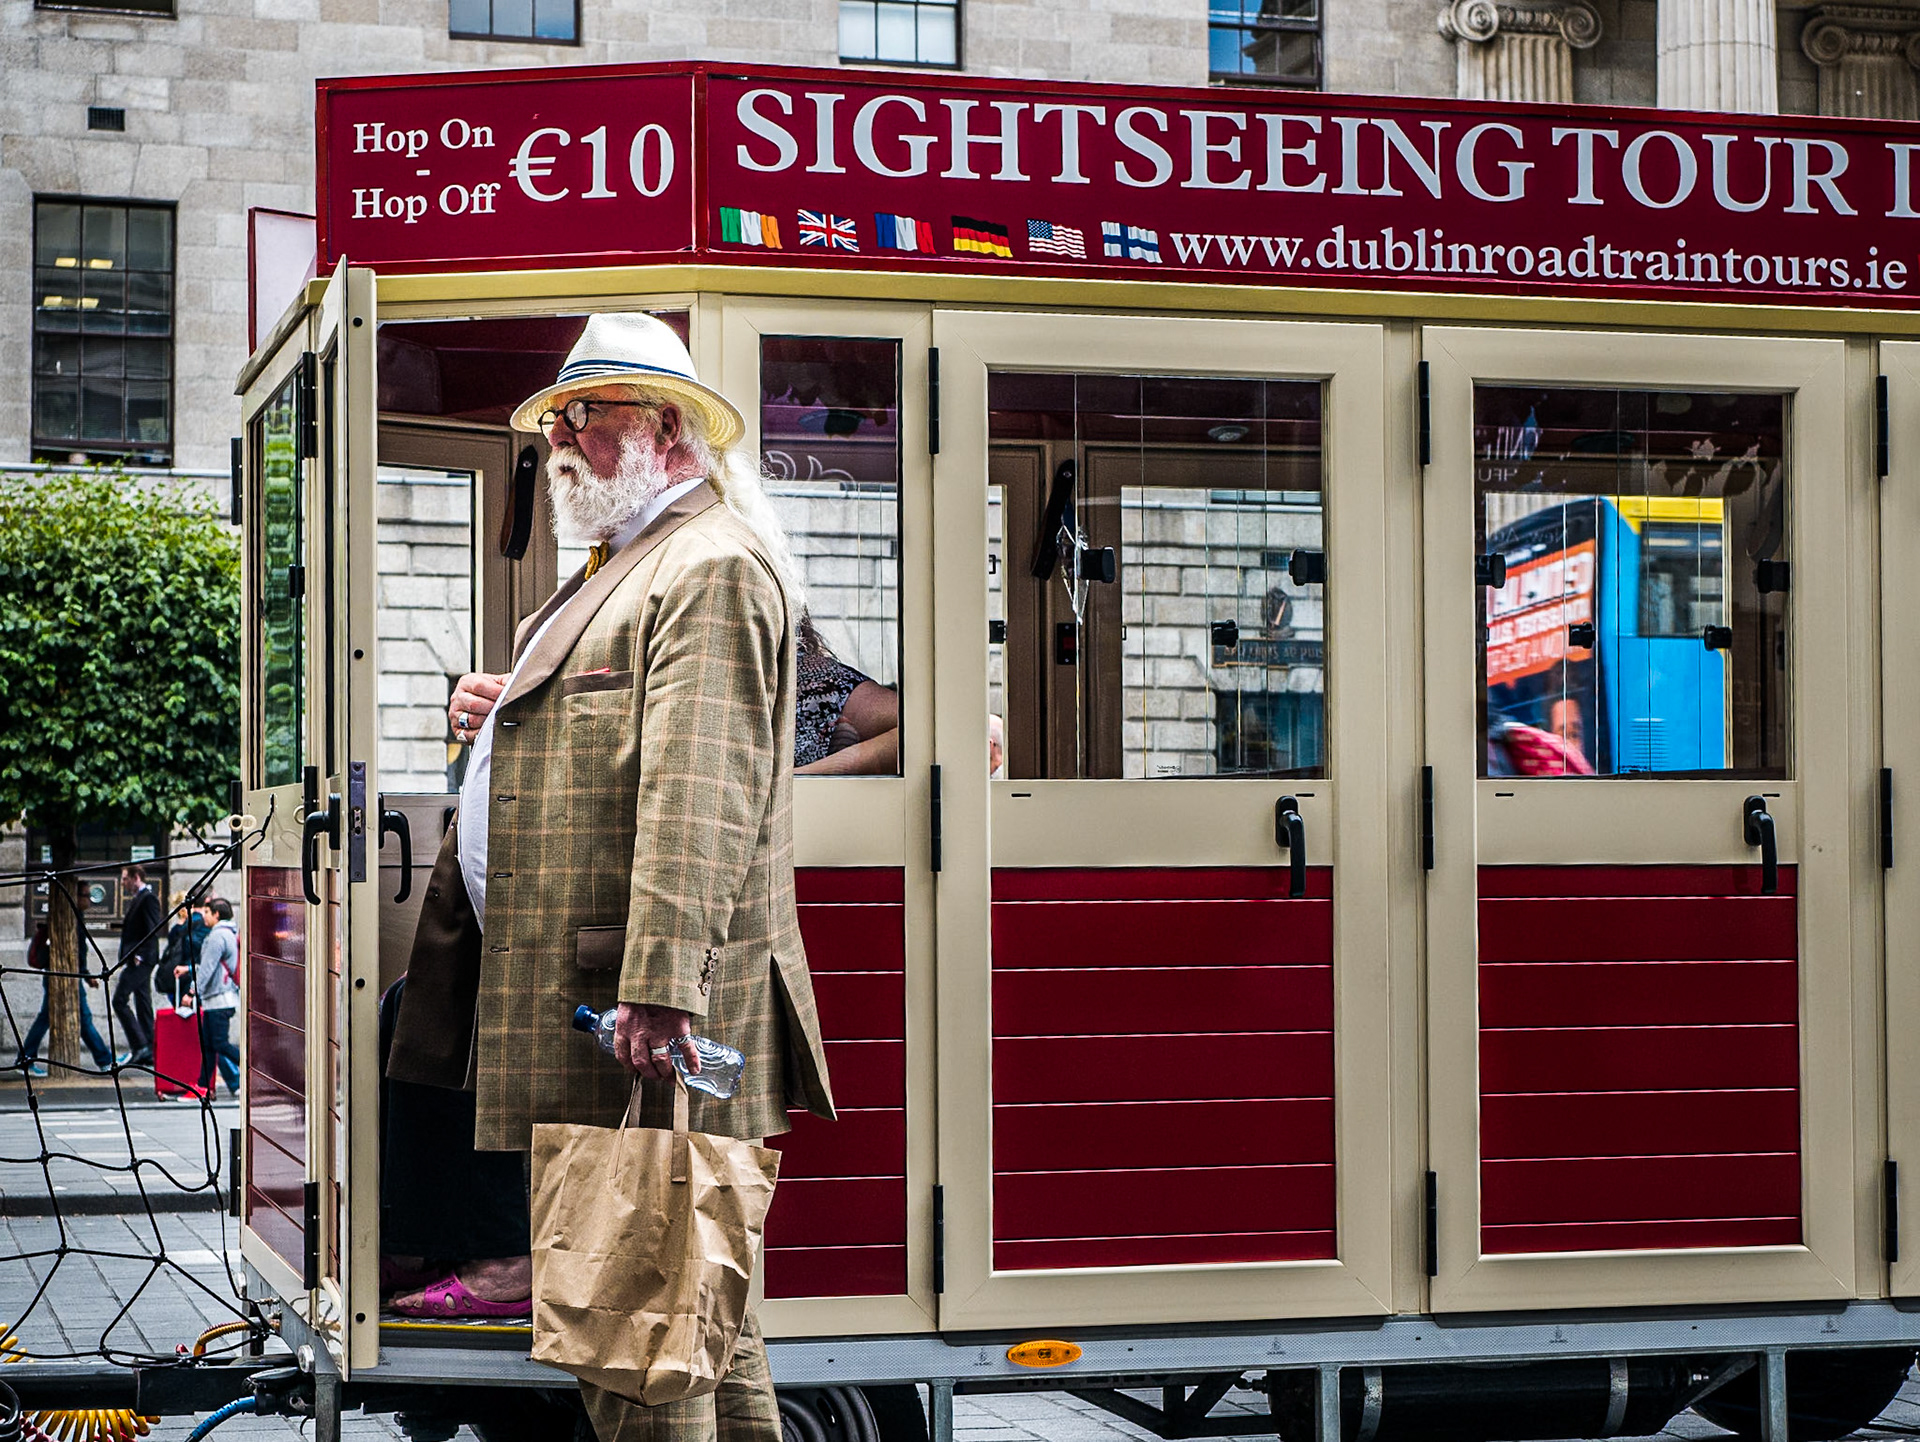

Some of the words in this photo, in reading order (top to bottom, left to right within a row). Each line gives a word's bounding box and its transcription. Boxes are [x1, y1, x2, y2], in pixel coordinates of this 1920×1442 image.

[352, 122, 429, 158] Hop
[439, 118, 496, 150] On
[508, 123, 675, 206] €10
[736, 87, 1534, 205] SIGHTSEEING
[1551, 128, 1859, 218] TOUR
[352, 187, 428, 224] Hop
[439, 182, 502, 216] Off
[1169, 224, 1908, 290] www.dublinroadtraintours.ie
